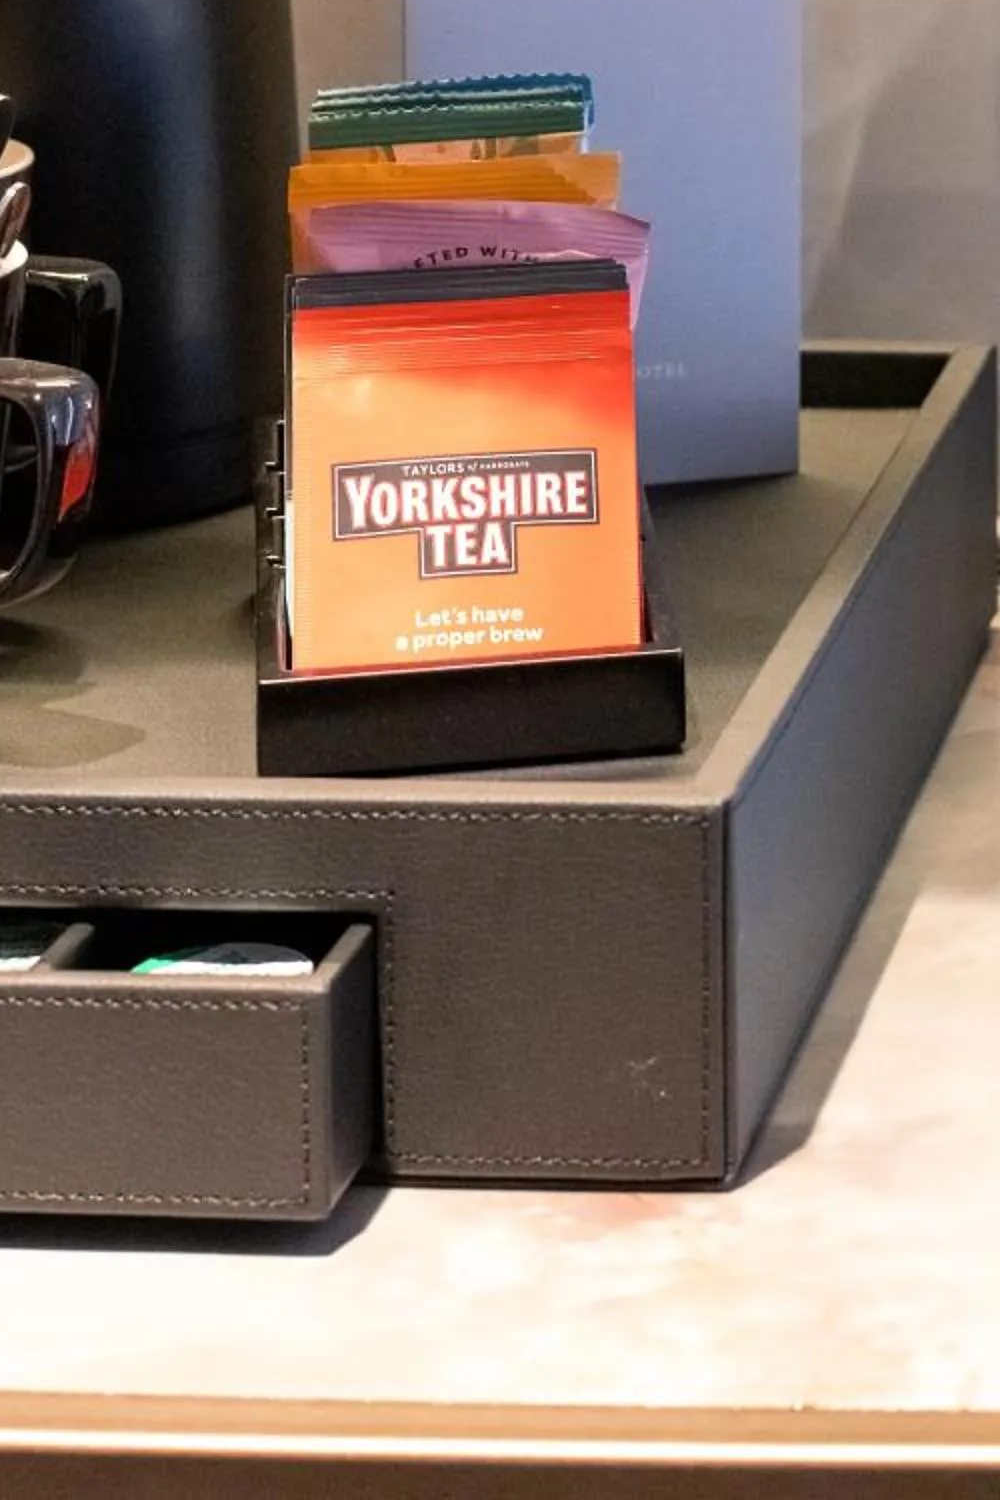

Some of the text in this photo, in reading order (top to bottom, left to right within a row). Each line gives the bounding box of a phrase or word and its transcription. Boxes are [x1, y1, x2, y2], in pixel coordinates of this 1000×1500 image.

[402, 463, 465, 476] TAYLORS
[343, 473, 588, 528] YORKSHIRE
[426, 522, 511, 568] TEA
[415, 606, 524, 628] Let's have
[396, 626, 543, 653] a proper brew
